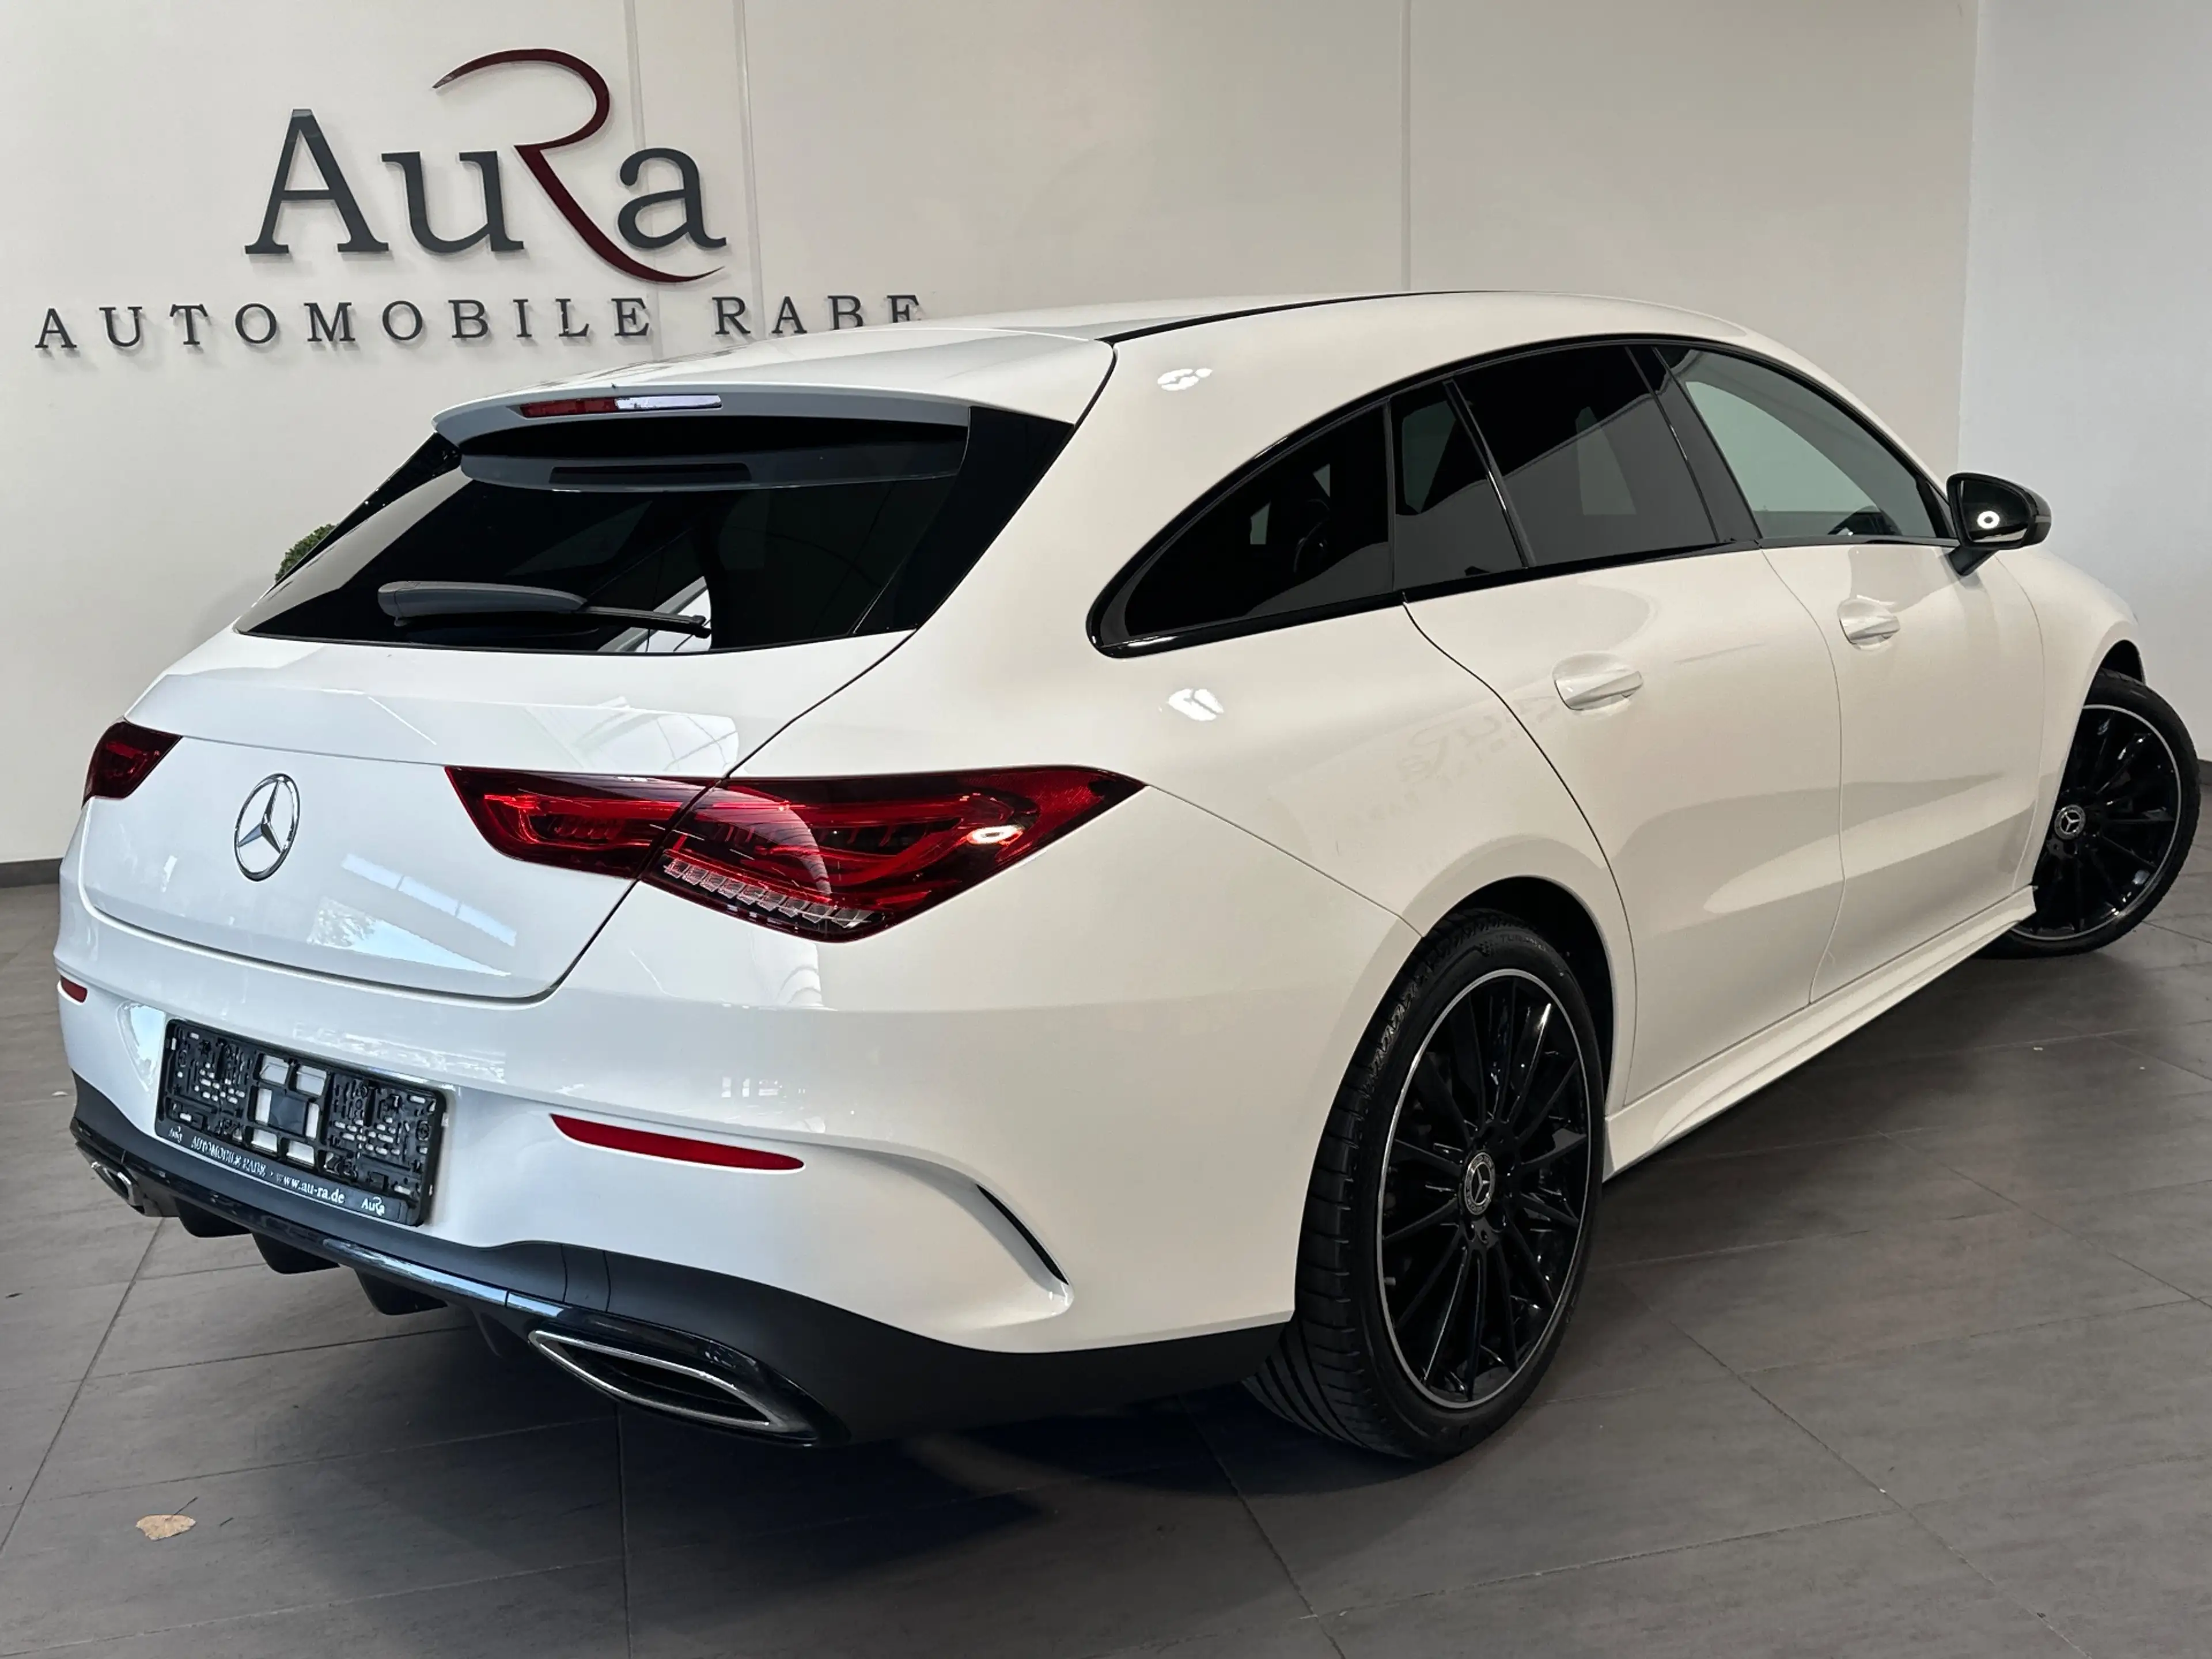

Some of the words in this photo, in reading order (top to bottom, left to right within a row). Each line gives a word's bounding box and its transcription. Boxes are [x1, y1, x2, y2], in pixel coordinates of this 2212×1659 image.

[244, 48, 727, 284] AuRa
[35, 297, 650, 350] AUTOMOBILE
[276, 1172, 346, 1205] www.au-ra.de
